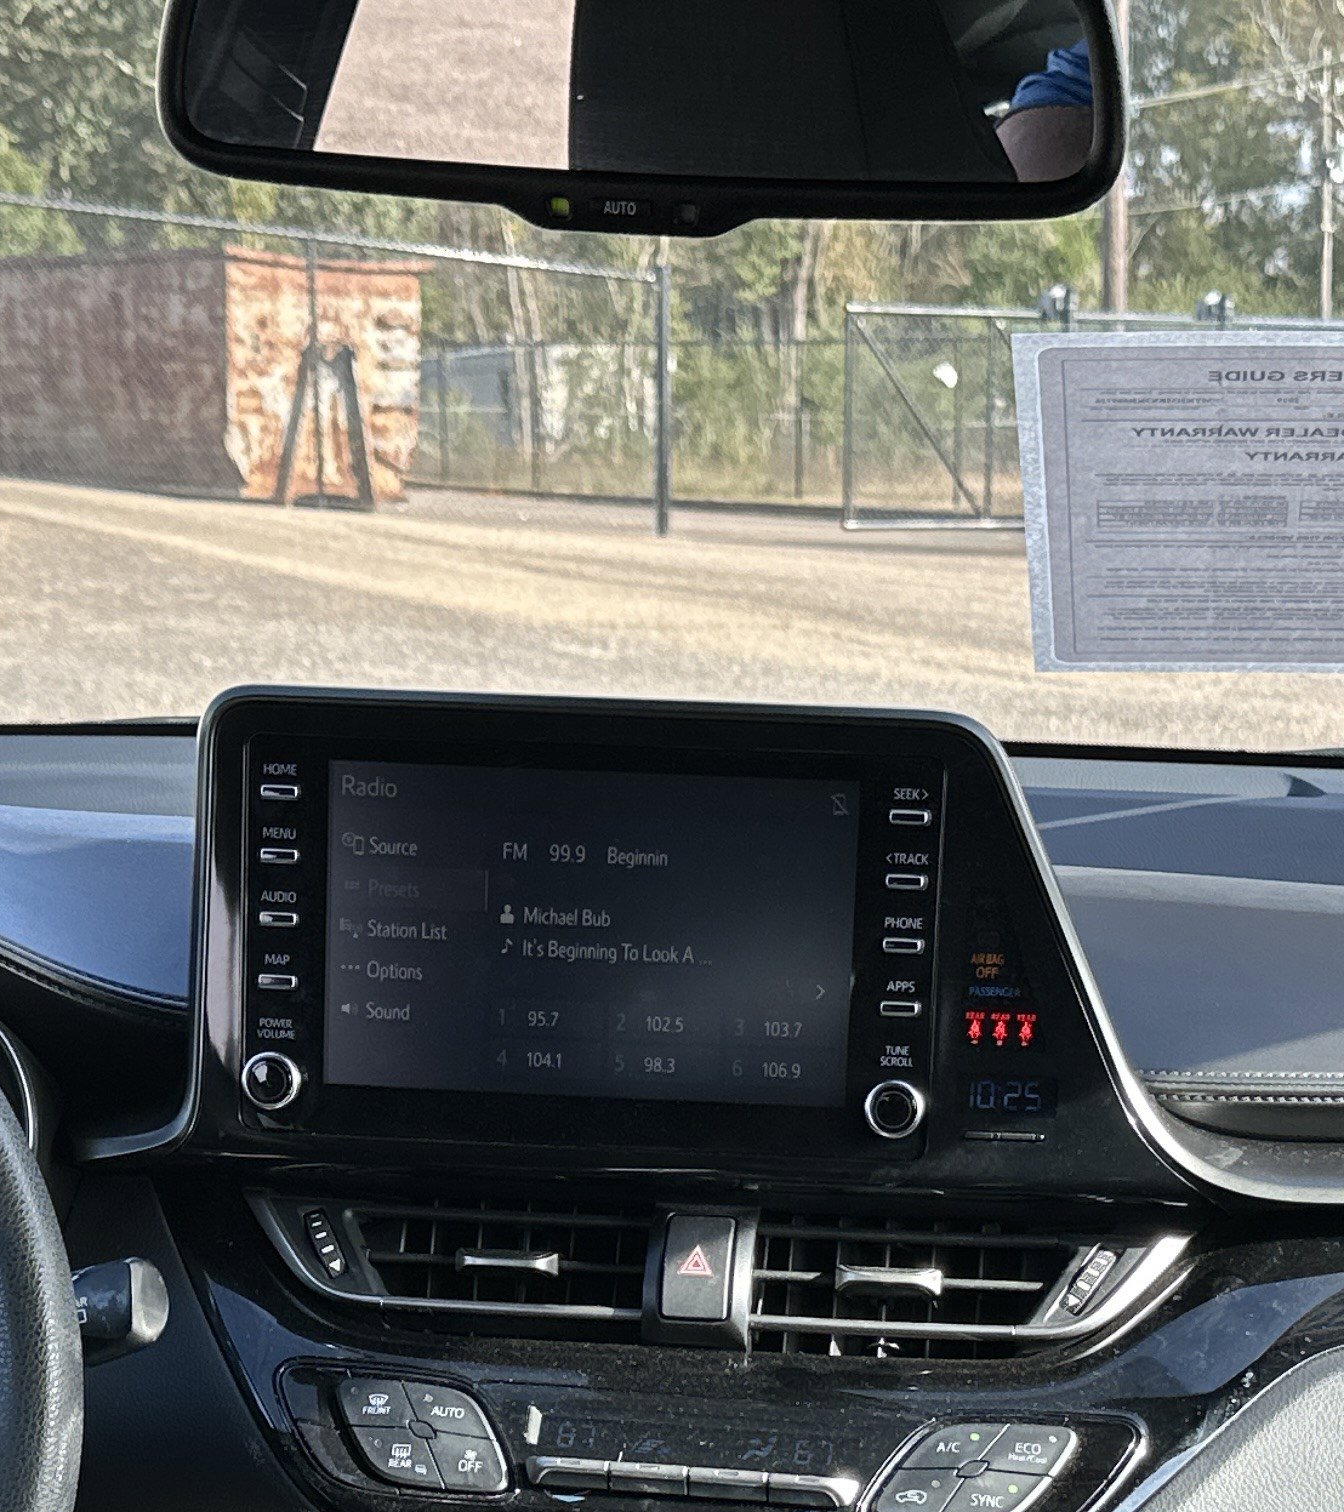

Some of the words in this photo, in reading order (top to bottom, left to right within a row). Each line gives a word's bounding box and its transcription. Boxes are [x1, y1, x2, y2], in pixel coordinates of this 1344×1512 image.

[603, 200, 637, 216] AUTO
[263, 764, 297, 776] HOME
[341, 774, 397, 798] Radio
[262, 827, 296, 840] MENU
[369, 836, 418, 856] Source
[502, 843, 528, 861] FM
[549, 844, 586, 863] 99.9
[607, 847, 668, 869] Beginnin
[368, 879, 419, 898] Presets
[261, 891, 296, 903] AUDIO
[524, 907, 578, 928] Michael
[582, 909, 611, 928] Bub
[884, 917, 923, 930] PHONE
[367, 920, 417, 939] Station
[422, 921, 447, 940] List
[264, 953, 290, 965] MAP
[522, 939, 544, 957] It's
[548, 941, 617, 963] Beginning
[621, 943, 639, 961] To
[642, 944, 678, 963] Look
[681, 945, 695, 963] A
[366, 961, 423, 981] Options
[976, 966, 999, 979] OFF
[887, 980, 915, 993] APPS
[366, 1003, 410, 1022] Sound
[528, 1010, 559, 1027] 95.7
[259, 1018, 292, 1029] POWER
[646, 1016, 684, 1033] 102.5
[764, 1021, 803, 1038] 103.7
[257, 1029, 296, 1040] VOLUME
[885, 1045, 910, 1056] TUNE
[527, 1052, 562, 1070] 104.1
[644, 1057, 675, 1074] 98.3
[880, 1055, 913, 1068] SCROLL
[761, 1062, 802, 1079] 106.9
[431, 1407, 465, 1419] AUTO
[936, 1441, 961, 1454] A/C
[1015, 1442, 1042, 1456] ECO
[458, 1460, 484, 1473] OFF
[970, 1493, 1005, 1509] SYNC
